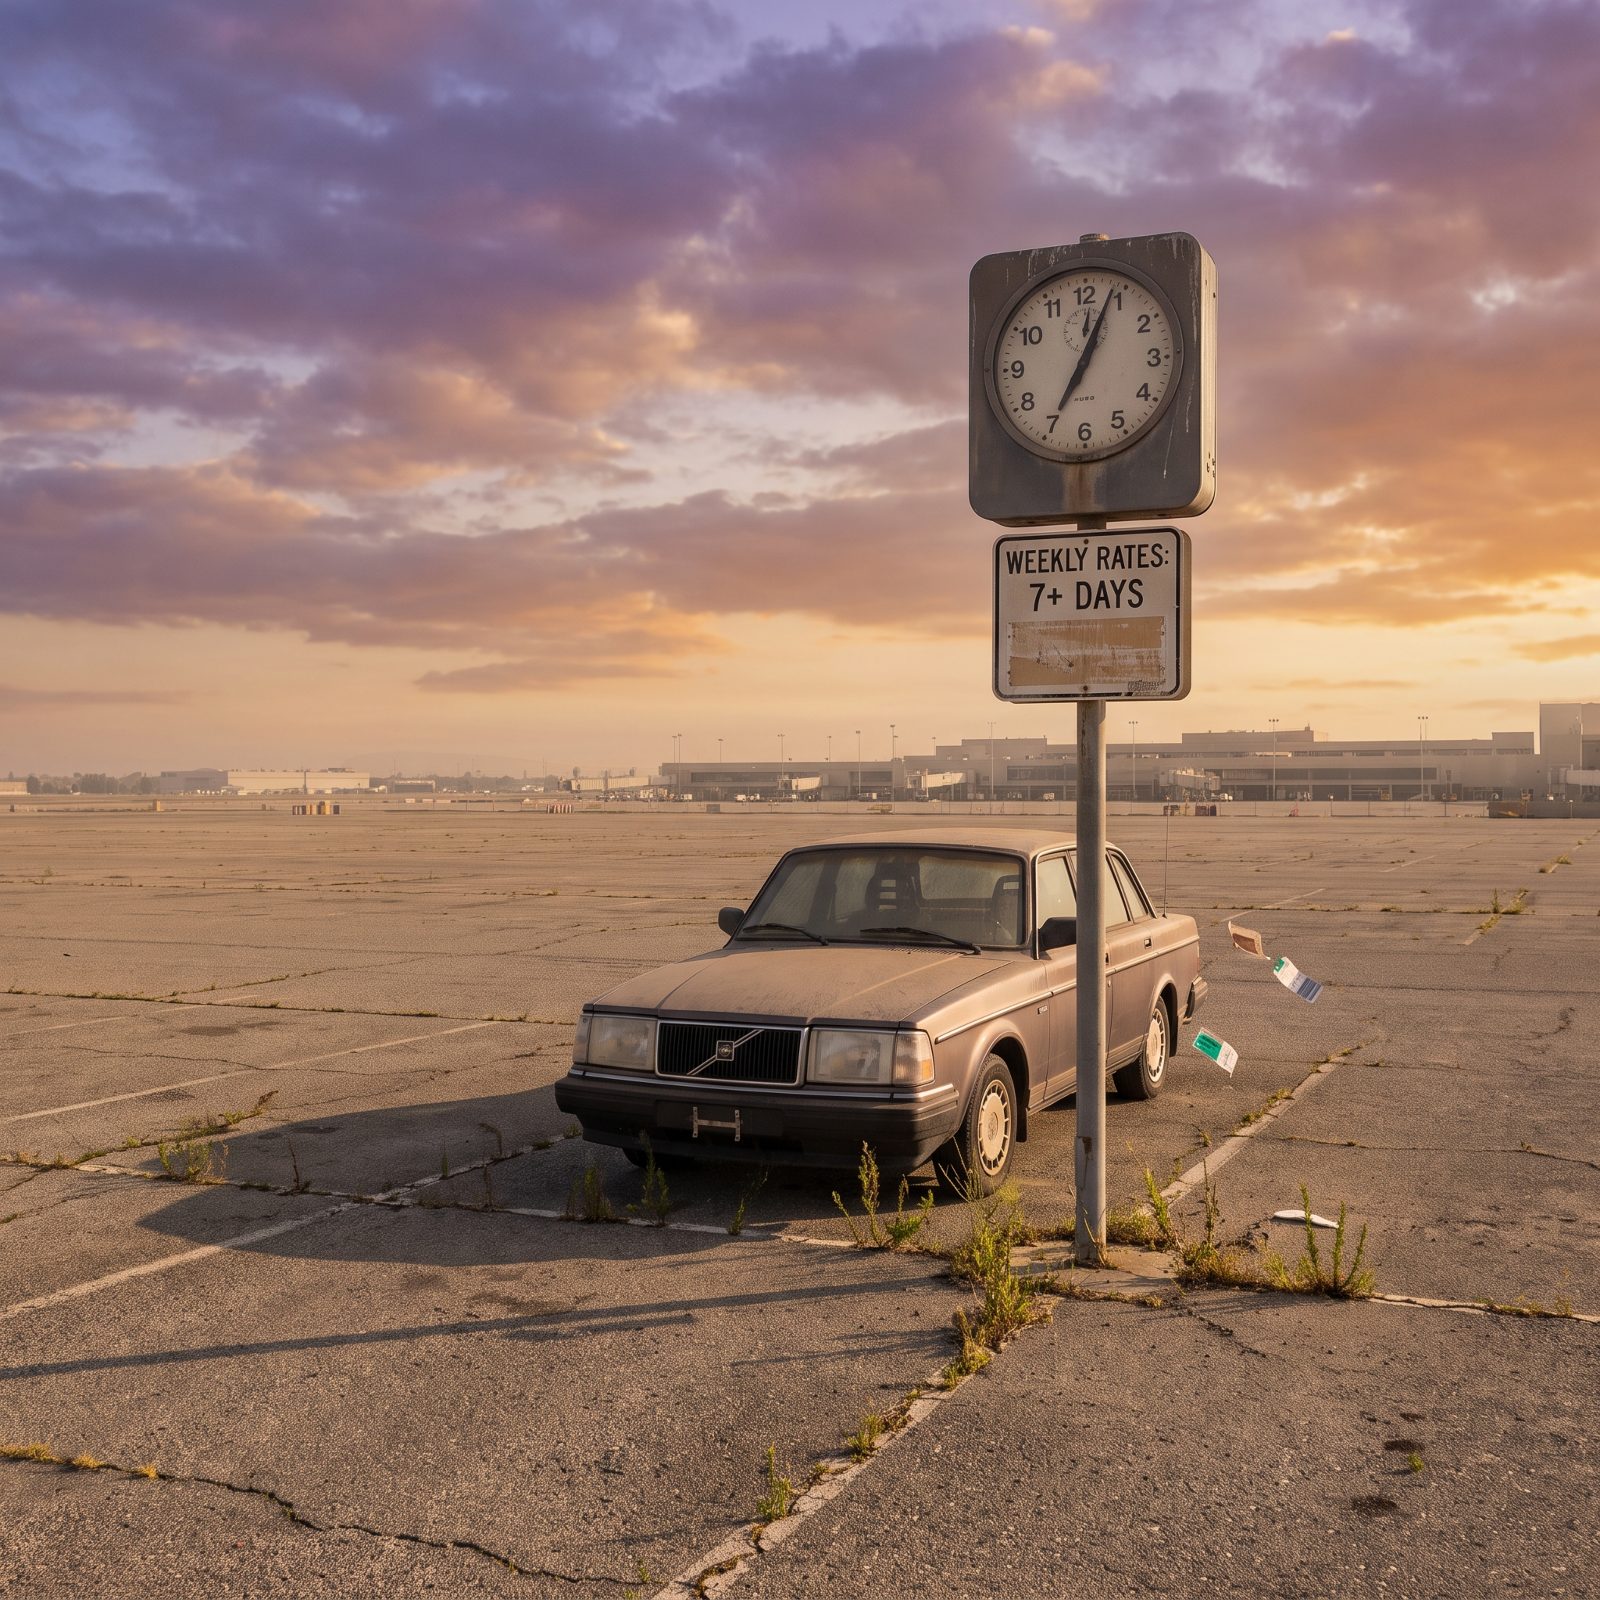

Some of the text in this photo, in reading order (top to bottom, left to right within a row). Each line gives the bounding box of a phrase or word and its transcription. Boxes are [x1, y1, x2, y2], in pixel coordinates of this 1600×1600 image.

[1073, 285, 1096, 305] 12
[1114, 293, 1122, 310] 1
[1044, 299, 1061, 318] 11
[1137, 314, 1150, 333] 2
[1019, 326, 1042, 345] 10
[1147, 348, 1161, 367] 3
[1011, 360, 1024, 379] 9
[1136, 382, 1150, 401] 4
[1021, 392, 1034, 411] 8
[1046, 415, 1060, 434] 7
[1111, 410, 1124, 429] 5
[1078, 422, 1091, 441] 6
[1006, 543, 1169, 574] WEEKLY RATES:
[1030, 579, 1143, 611] 7+ DAYS
